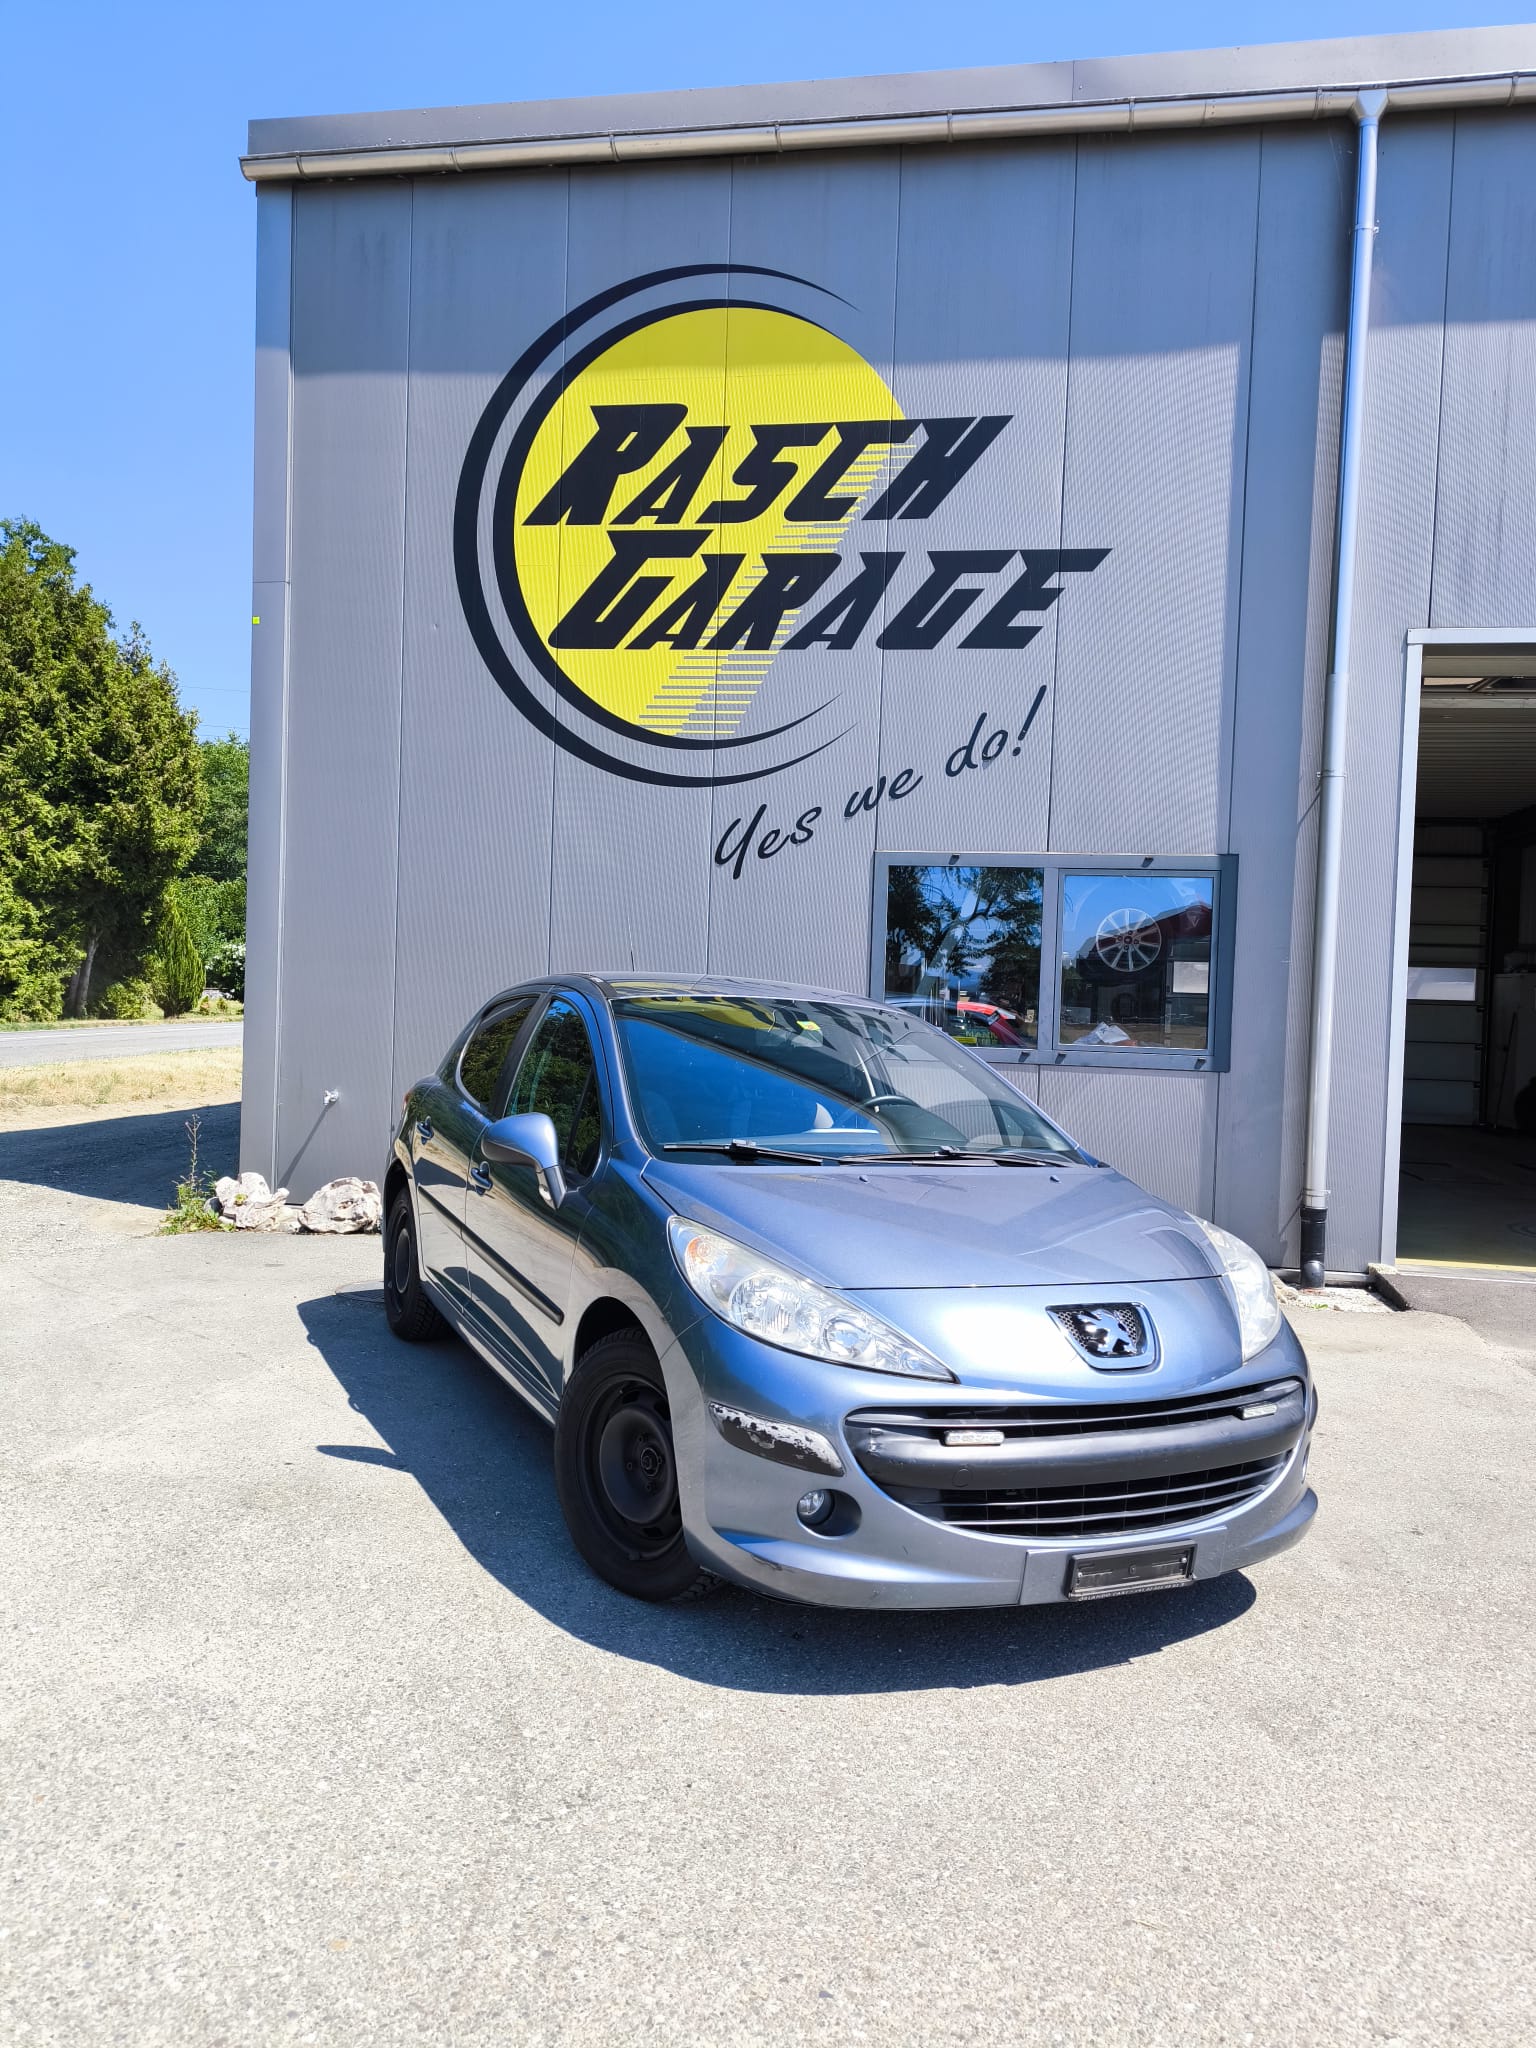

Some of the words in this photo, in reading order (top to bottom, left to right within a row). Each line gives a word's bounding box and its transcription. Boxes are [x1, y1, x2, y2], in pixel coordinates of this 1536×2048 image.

[522, 403, 1014, 525] RASCH
[547, 529, 1113, 650] GARAGE
[714, 803, 822, 880] Yes
[844, 768, 924, 818] we
[945, 685, 1047, 777] do!
